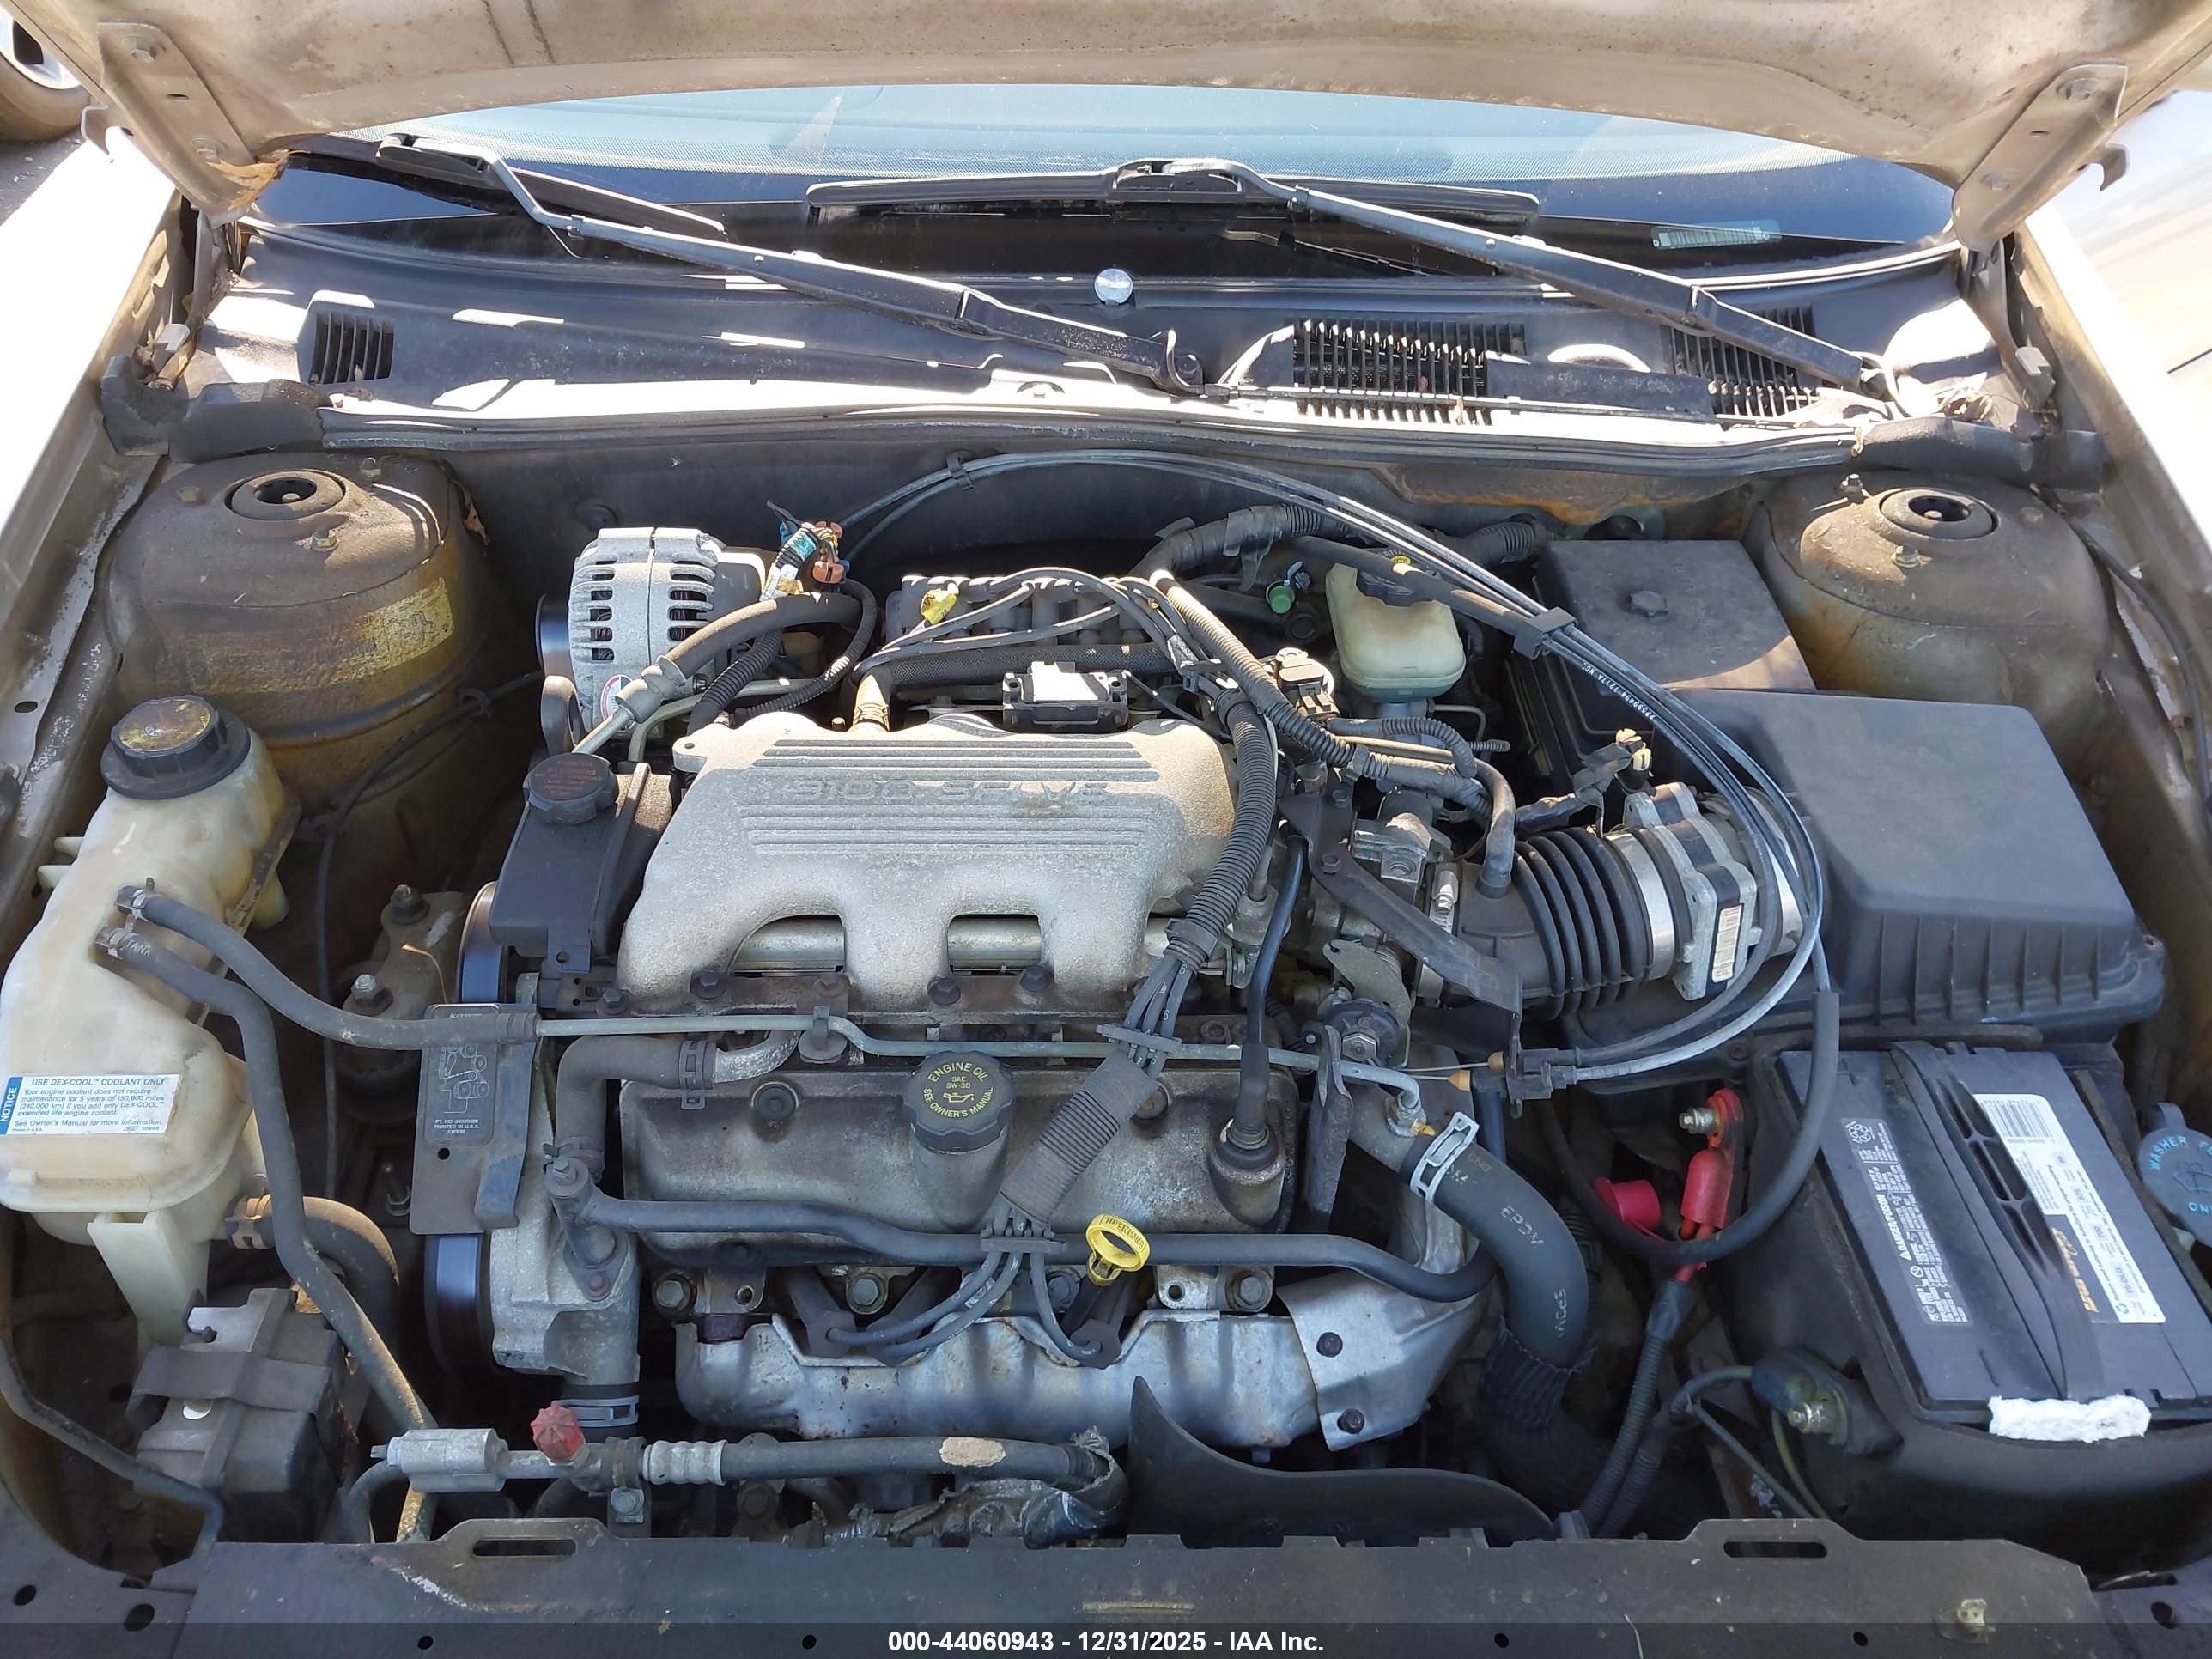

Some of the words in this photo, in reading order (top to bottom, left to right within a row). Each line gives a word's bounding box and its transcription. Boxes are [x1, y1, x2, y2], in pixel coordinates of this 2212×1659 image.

[1163, 1009, 1170, 1021] 6
[927, 1061, 973, 1083] ENGINE
[972, 1066, 988, 1082] OIL
[0, 1087, 17, 1122] NOTICE
[923, 1087, 933, 1103] SEE
[930, 1102, 969, 1118] OWNER'S
[969, 1086, 994, 1115] MANUAL
[2149, 1135, 2188, 1170] WASHER
[1017, 1222, 1024, 1231] 4
[1875, 1194, 1908, 1251] DANGER/POISON
